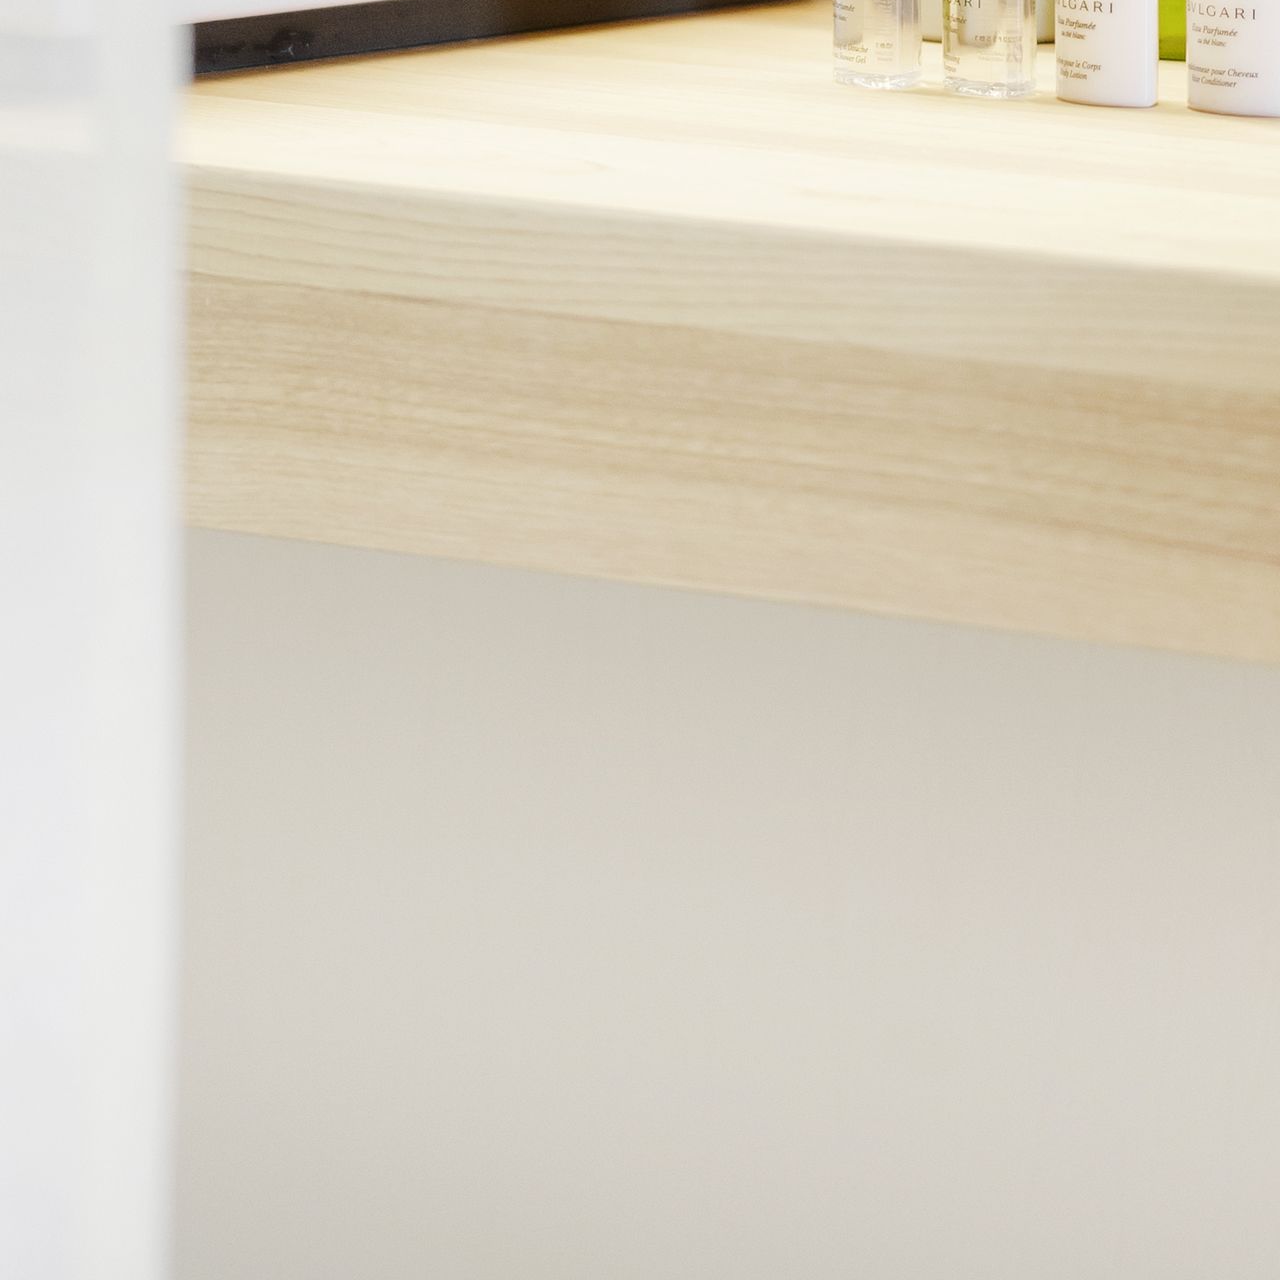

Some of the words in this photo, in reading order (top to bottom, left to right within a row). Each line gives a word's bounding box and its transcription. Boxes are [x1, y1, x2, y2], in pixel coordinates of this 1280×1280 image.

[1202, 25, 1239, 37] Parfumée
[1082, 61, 1101, 72] Corps
[1227, 68, 1259, 78] Cheveux
